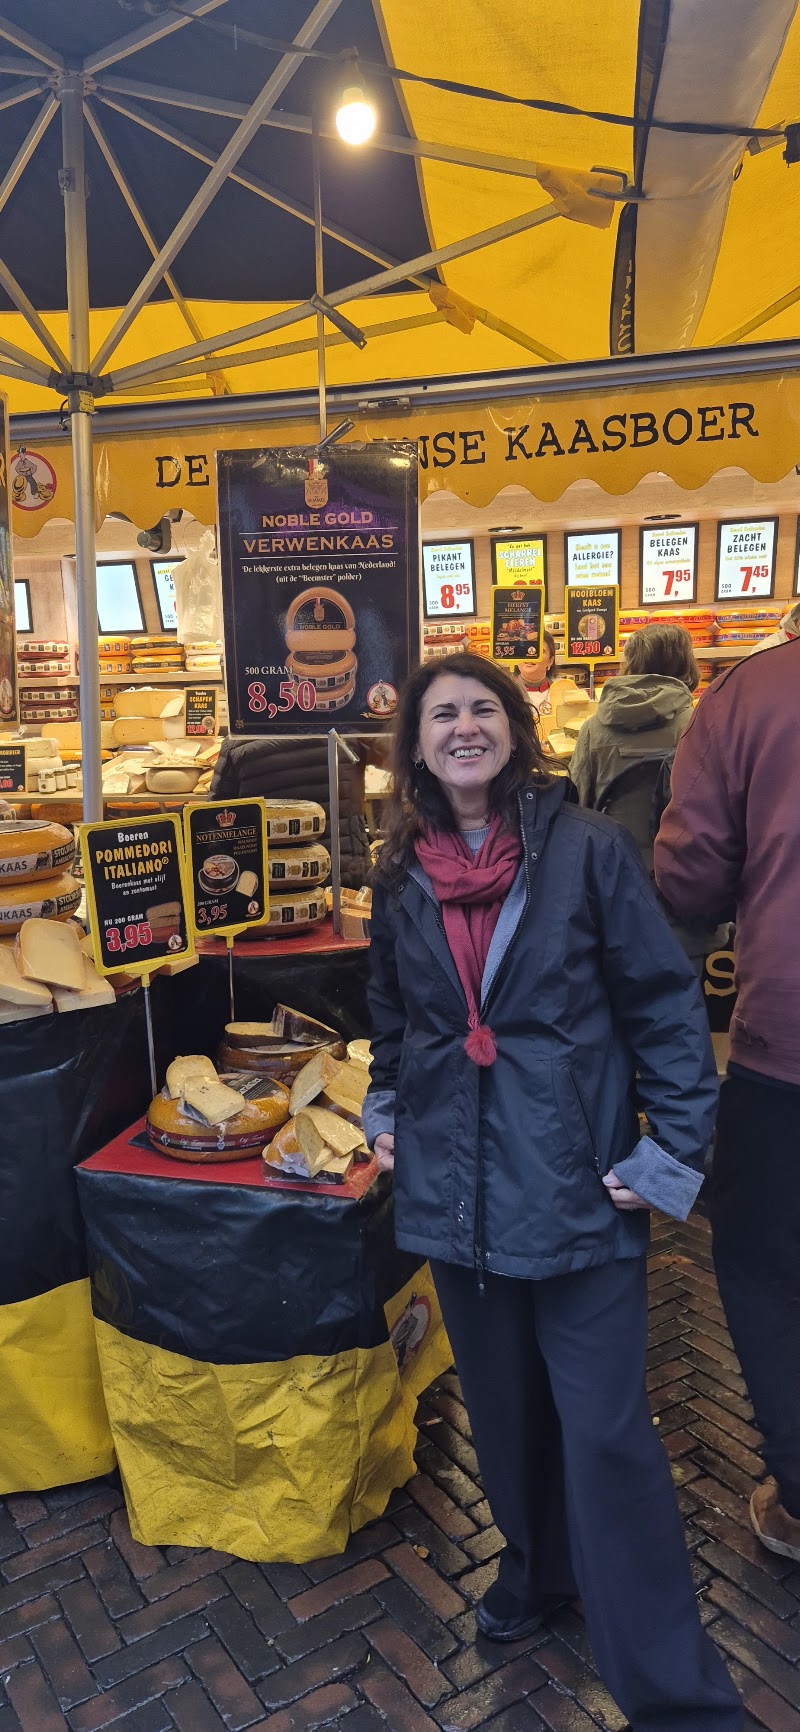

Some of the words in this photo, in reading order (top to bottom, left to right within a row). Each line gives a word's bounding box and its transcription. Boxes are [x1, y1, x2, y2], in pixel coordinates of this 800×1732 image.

[156, 455, 210, 488] DE
[504, 402, 760, 462] KAASBOER
[262, 513, 321, 528] NOBLE
[324, 511, 374, 526] GOLD
[243, 534, 394, 554] VERWENKAAS
[650, 537, 688, 547] BELEGEN
[733, 533, 762, 543] ZACHT
[499, 548, 542, 559] SCHARREL
[657, 548, 680, 557] KAAS
[727, 543, 767, 553] BELEGEN
[432, 553, 462, 562] PIKANT
[572, 551, 614, 561] ALLERGIE?
[242, 565, 252, 573] De
[253, 564, 282, 573] lekkerste
[301, 563, 327, 572] belegen
[328, 562, 343, 571] kaas
[345, 562, 357, 570] van
[358, 560, 396, 569] Nederland!
[430, 562, 465, 572] BELEGEN
[505, 557, 536, 568] EIEREN
[276, 575, 288, 583] (uit
[337, 572, 362, 582] polder)
[662, 569, 691, 597] 7,95
[740, 565, 769, 593] 7,45
[440, 583, 471, 609] 8,95
[570, 589, 614, 598] HOOIBLOEM
[582, 599, 602, 607] KAAS
[495, 645, 515, 657] 3,95
[571, 641, 600, 655] 12,50
[245, 666, 260, 676] 500
[261, 665, 293, 675] GRAM
[247, 680, 317, 719] 8,50
[117, 831, 149, 843] Boeren
[195, 827, 257, 842] NOTENMELANGE
[96, 840, 173, 864] POMMEDORI
[111, 879, 142, 890] Boerenkaas
[155, 873, 166, 883] olijf
[115, 917, 126, 925] 200
[127, 913, 144, 922] GRAM
[197, 904, 228, 925] 3,95
[105, 922, 152, 952] 3,95
